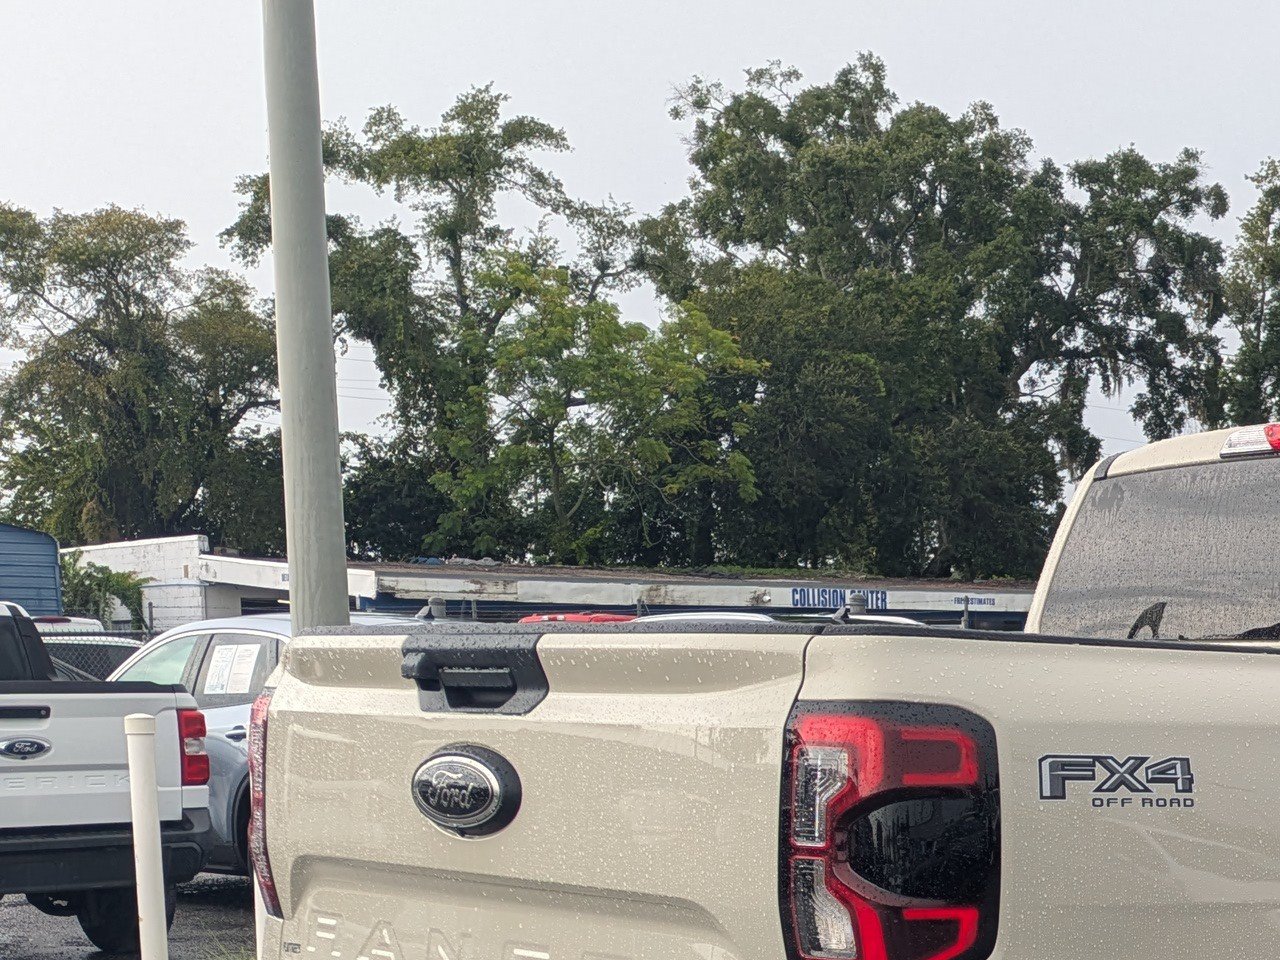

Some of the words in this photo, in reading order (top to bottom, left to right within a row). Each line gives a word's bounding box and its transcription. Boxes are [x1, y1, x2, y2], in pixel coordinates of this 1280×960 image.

[791, 587, 846, 608] COLLISION
[849, 589, 887, 610] NTER
[13, 742, 37, 752] Ford
[1038, 754, 1194, 800] FX4
[428, 769, 474, 809] Ford
[1091, 797, 1132, 807] OFF
[1142, 797, 1194, 807] ROAD
